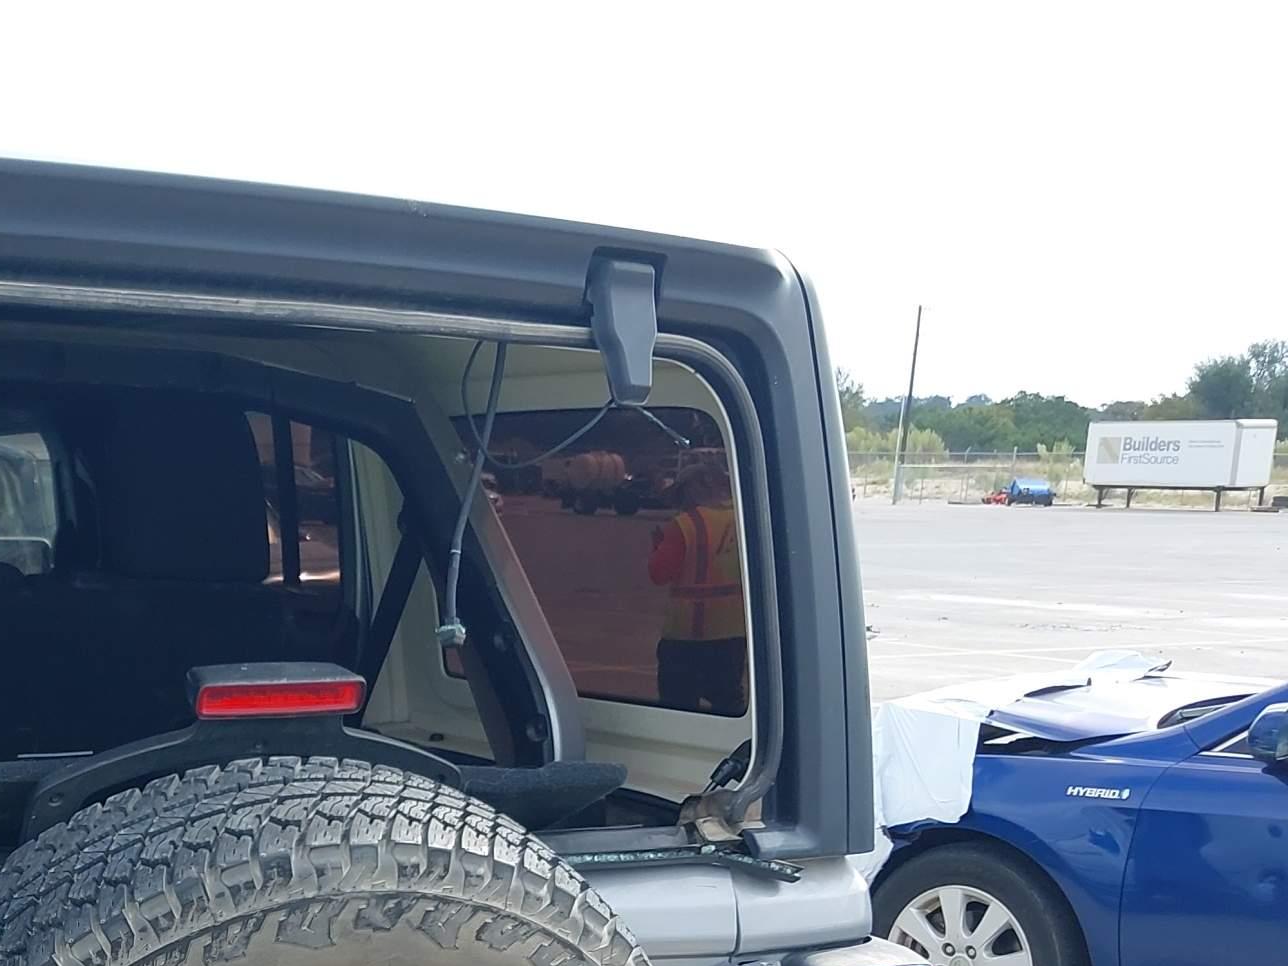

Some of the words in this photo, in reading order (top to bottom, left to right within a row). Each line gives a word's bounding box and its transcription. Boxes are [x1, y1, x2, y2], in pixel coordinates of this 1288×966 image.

[1122, 437, 1181, 452] Builders
[1120, 453, 1179, 465] FirstSource
[1066, 786, 1120, 799] HYBRID
